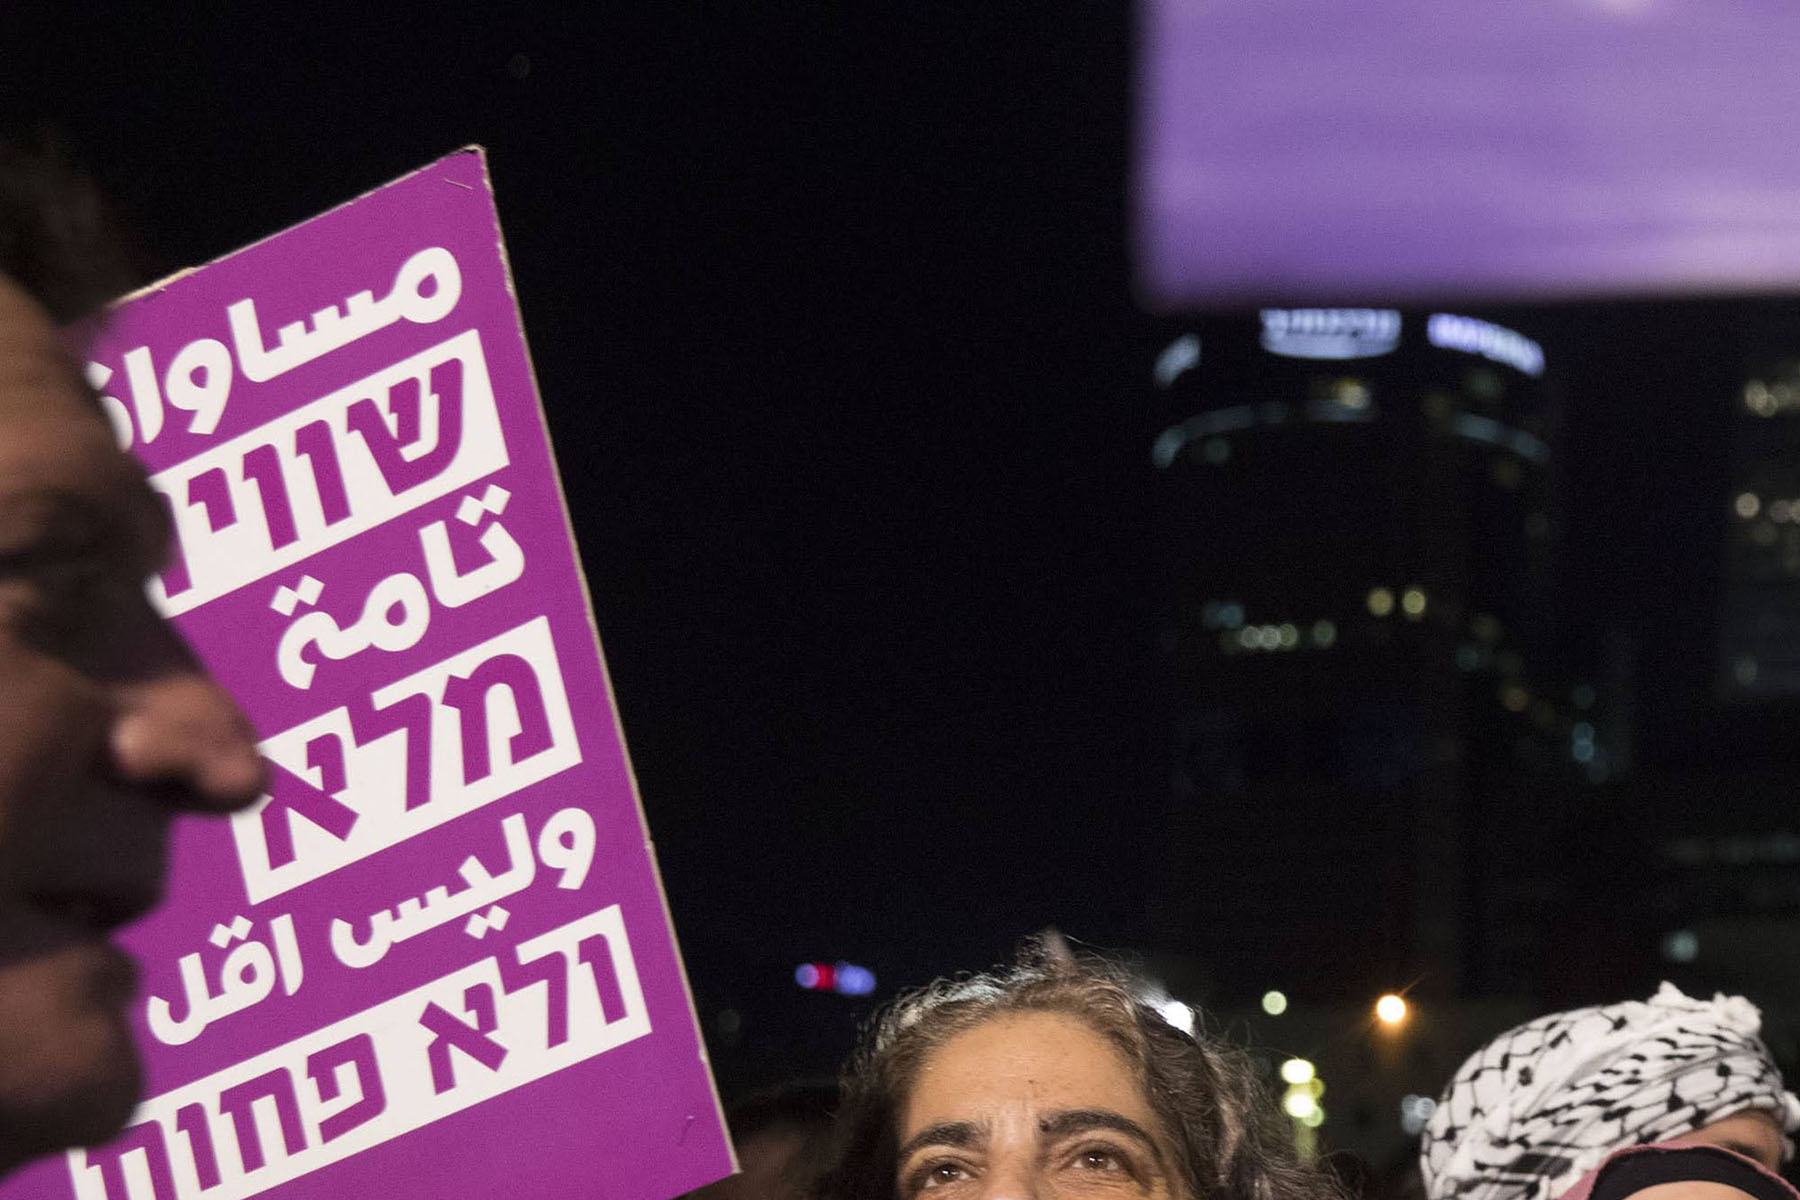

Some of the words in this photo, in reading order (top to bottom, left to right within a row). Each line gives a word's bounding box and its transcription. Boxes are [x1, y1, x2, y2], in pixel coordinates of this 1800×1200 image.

[275, 484, 527, 690] تامة
[255, 645, 558, 874] מלא
[330, 806, 598, 972] وليس
[145, 902, 306, 1046] اقل
[413, 930, 628, 1098] ולא
